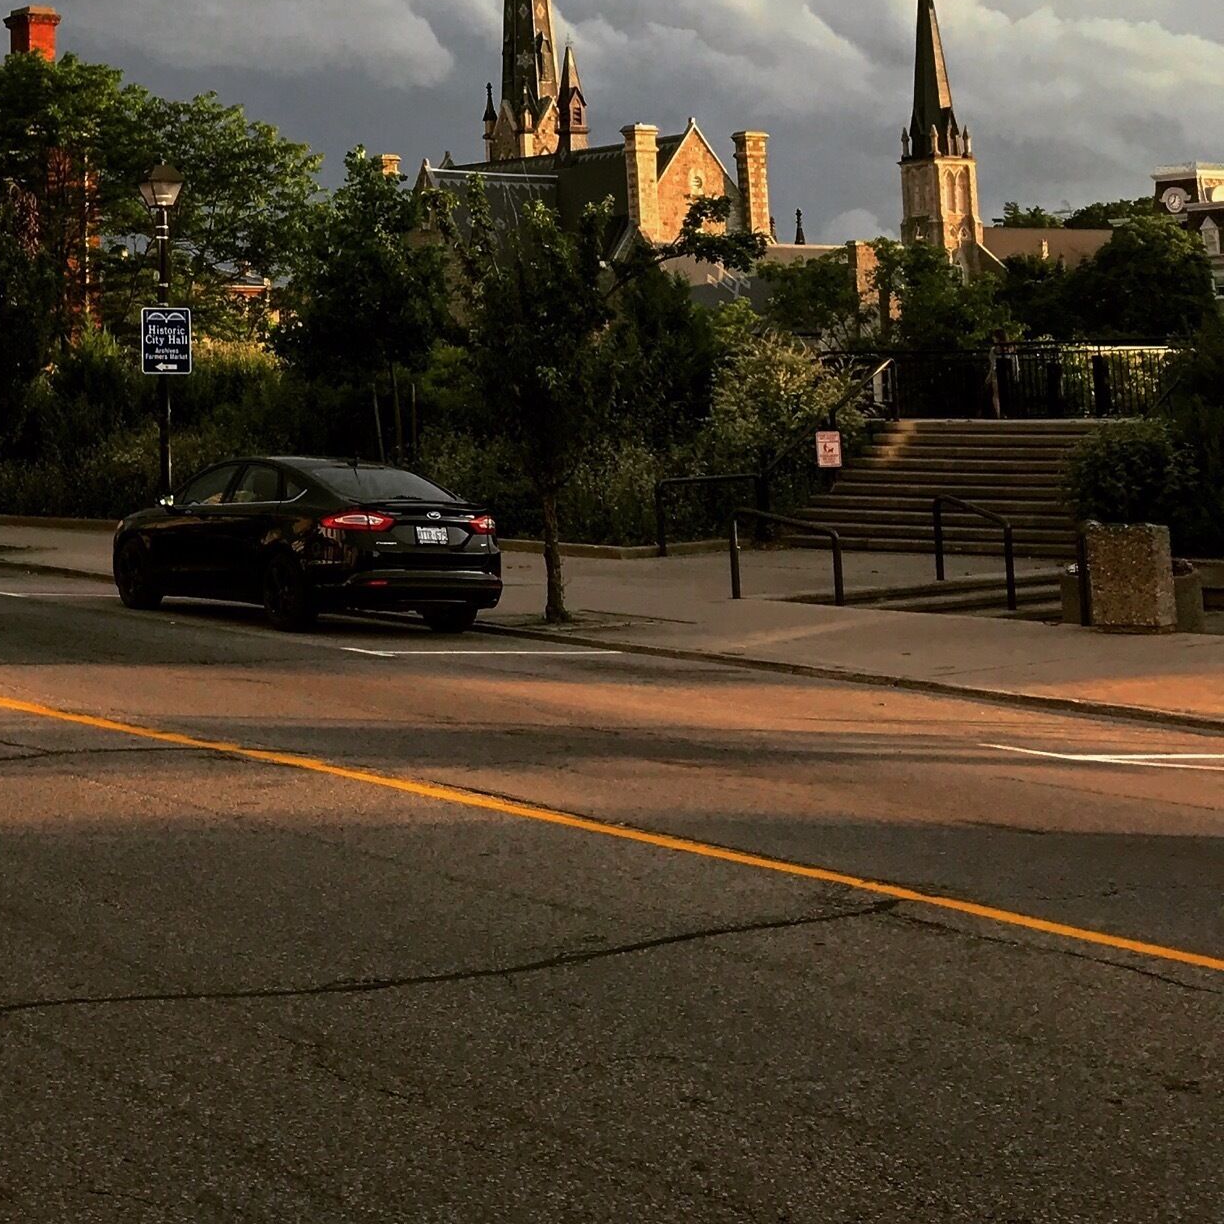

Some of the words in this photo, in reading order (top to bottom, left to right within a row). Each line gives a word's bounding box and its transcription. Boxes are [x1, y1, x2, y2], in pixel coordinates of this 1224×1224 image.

[148, 324, 186, 335] Historic
[145, 334, 165, 346] City
[168, 334, 188, 345] Hall
